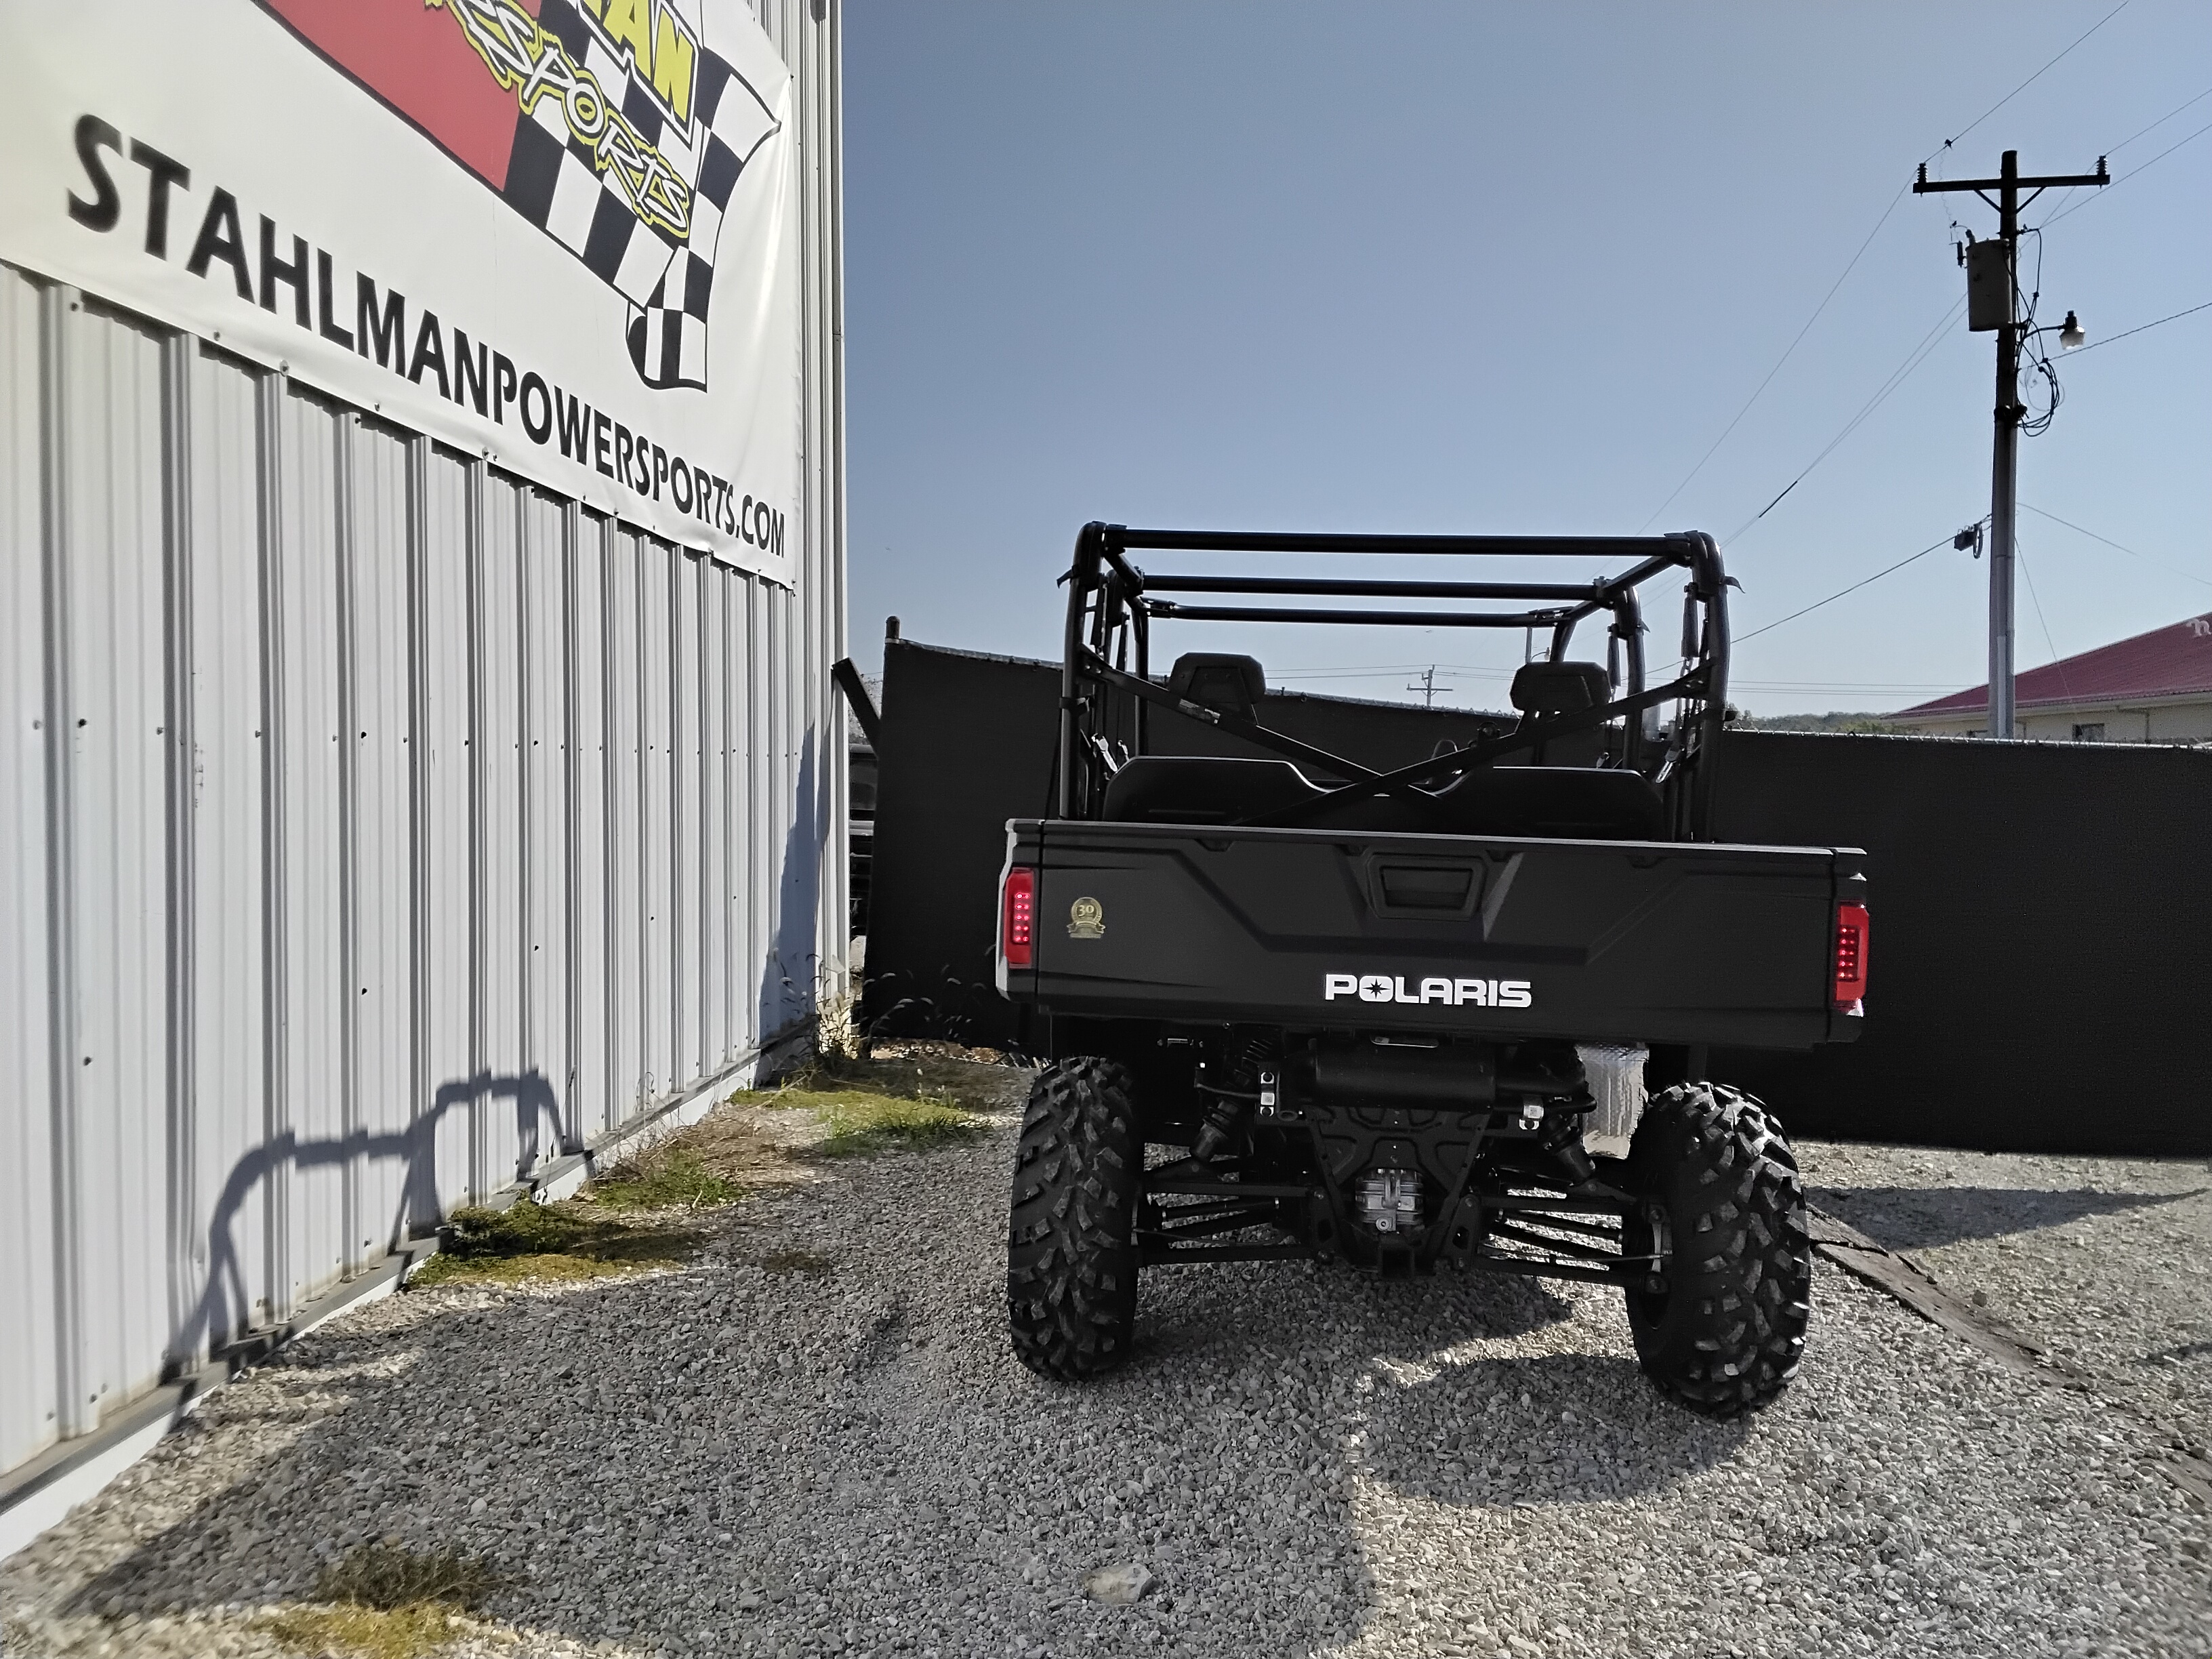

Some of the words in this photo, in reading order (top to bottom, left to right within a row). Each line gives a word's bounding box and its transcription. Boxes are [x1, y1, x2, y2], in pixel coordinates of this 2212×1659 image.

[583, 0, 693, 123] AN
[67, 113, 785, 558] STAHLMANPOWERSPORTS.COM
[1078, 905, 1094, 916] 30
[1326, 974, 1531, 1007] POLARIS
